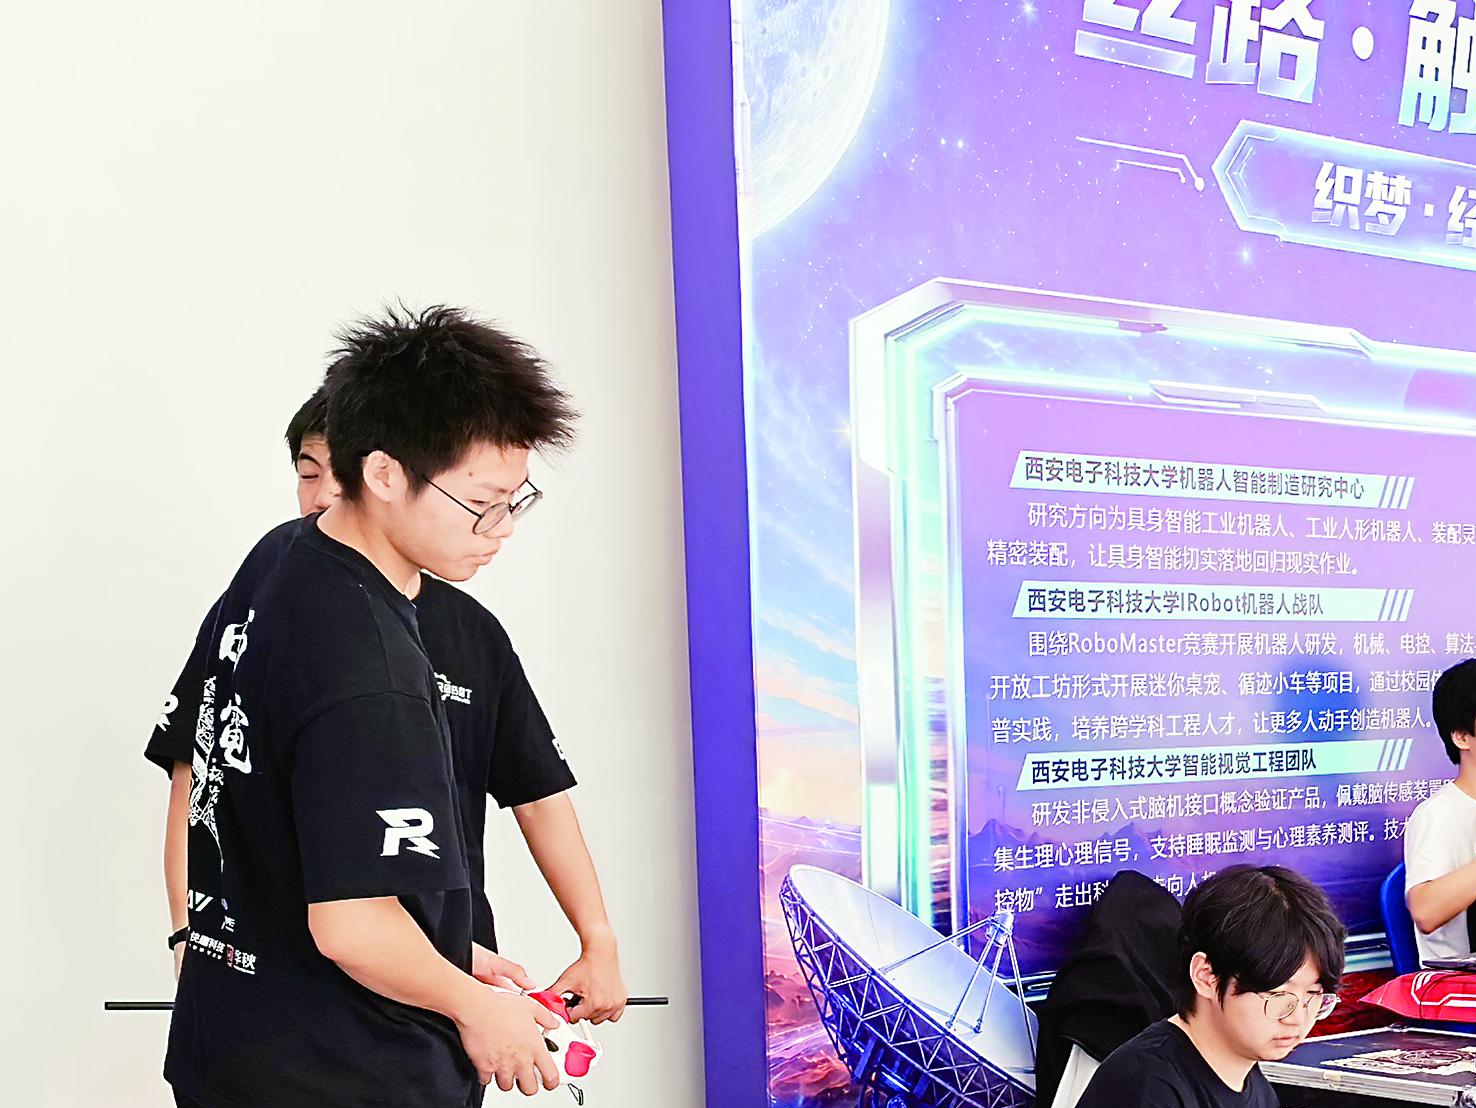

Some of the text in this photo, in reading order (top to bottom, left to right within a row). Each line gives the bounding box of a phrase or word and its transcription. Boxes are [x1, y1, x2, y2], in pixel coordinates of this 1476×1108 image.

[1024, 456, 1365, 500] 西安电子科技大学机器人智能制造研究中心
[986, 538, 1358, 576] 精密装配，让具身智能切实落地回归现实作业。
[1031, 748, 1317, 785] 西安电子科技大学智能视觉工程团队
